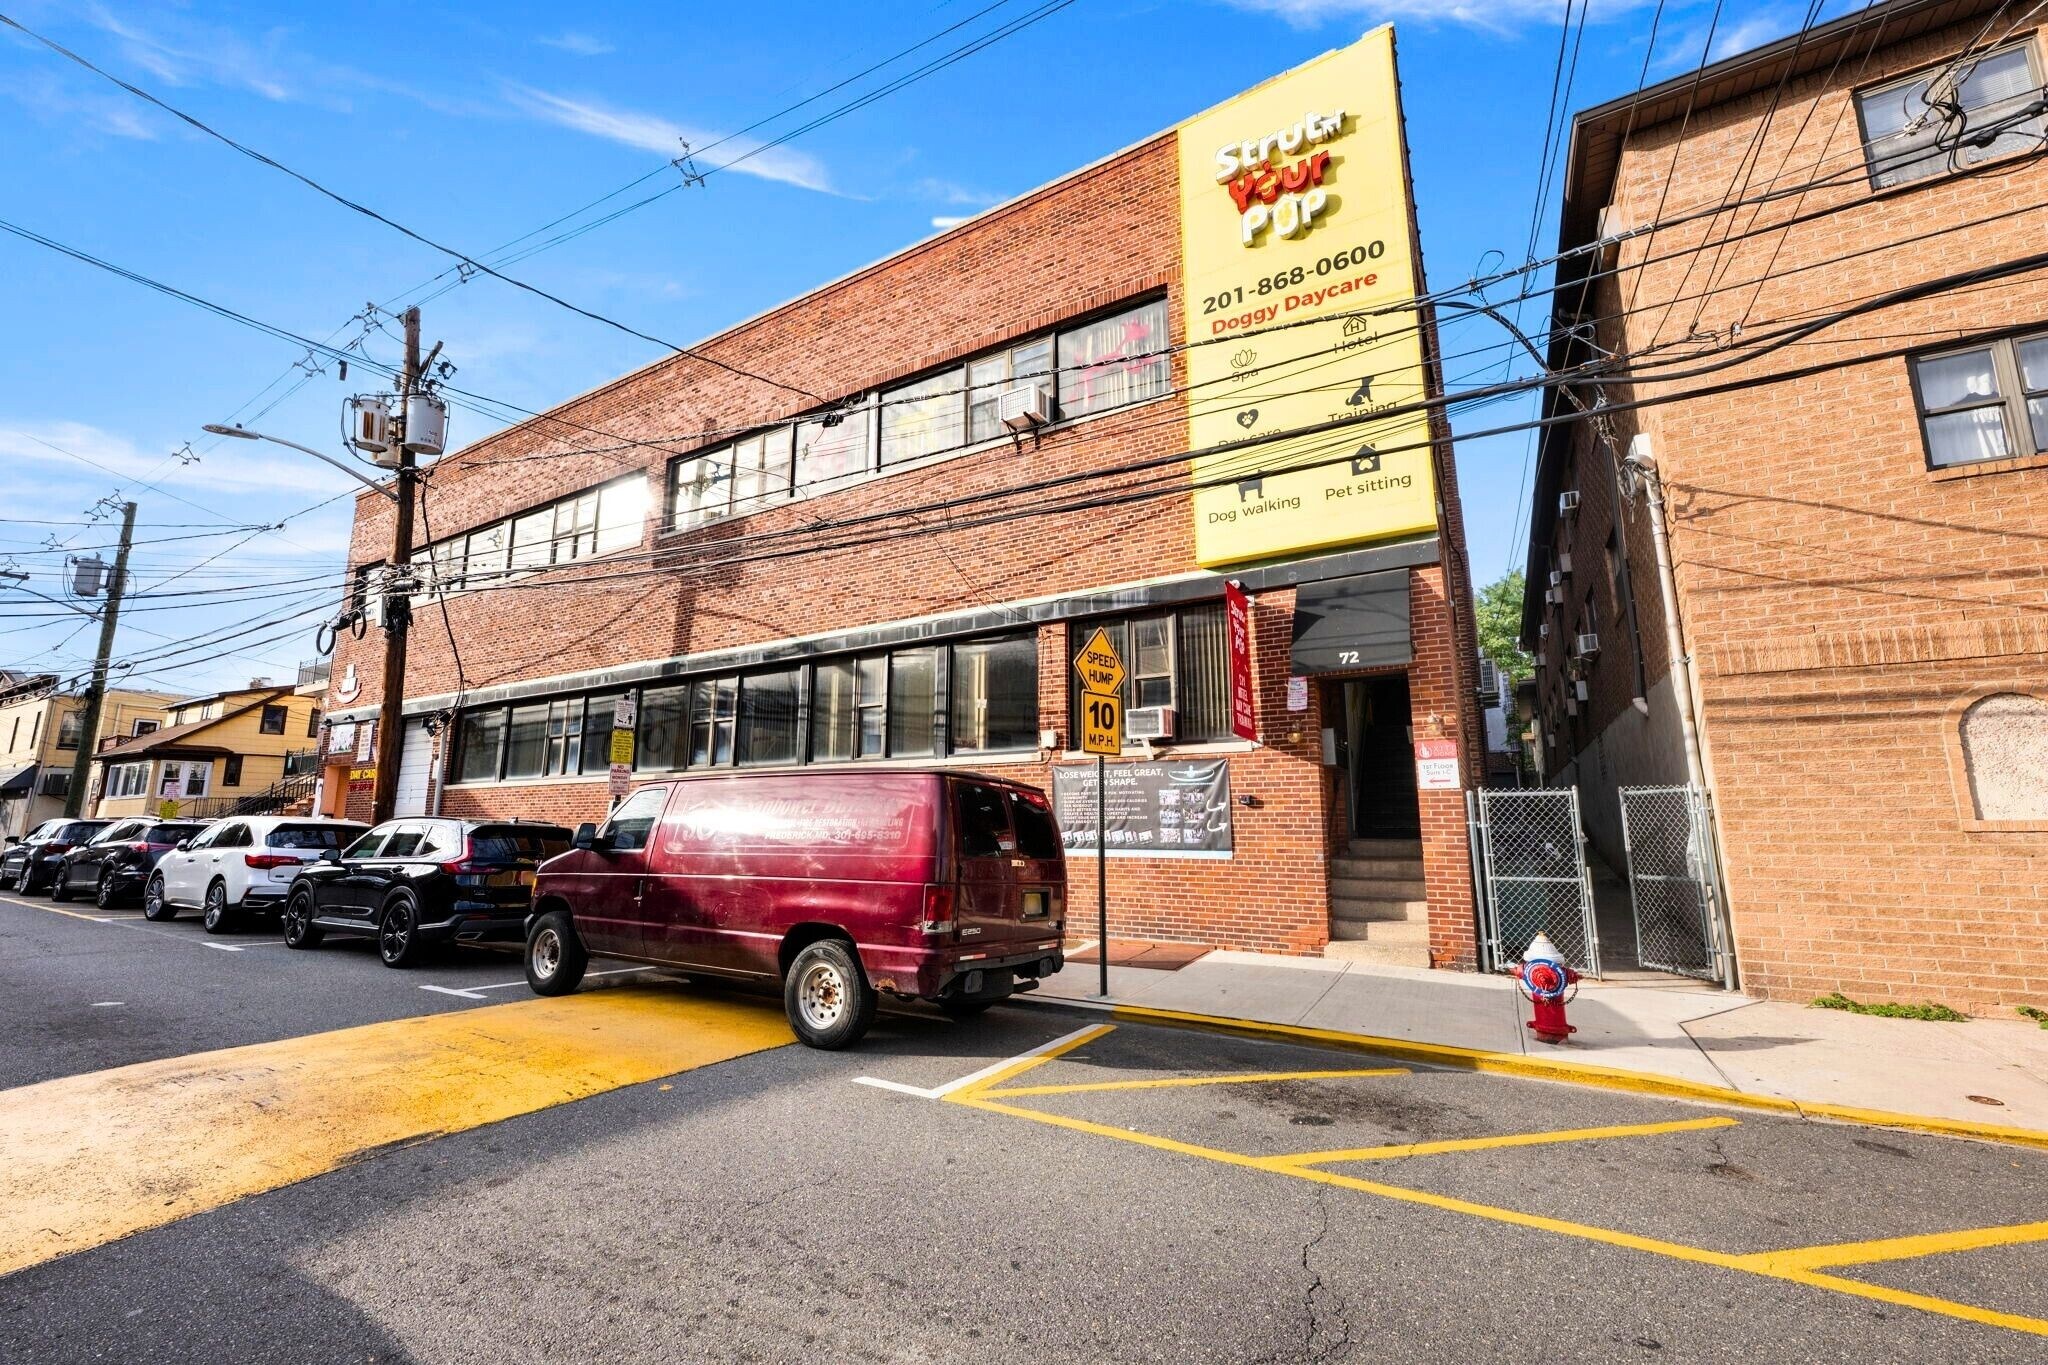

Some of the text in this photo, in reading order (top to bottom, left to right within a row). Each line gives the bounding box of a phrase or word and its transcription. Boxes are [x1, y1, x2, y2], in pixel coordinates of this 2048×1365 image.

[1203, 240, 1386, 315] 201-868-0600
[1212, 272, 1378, 335] Doggy Daycare
[1333, 331, 1379, 354] Hotel
[1231, 367, 1259, 385] Spa
[1325, 473, 1413, 501] Pet sitting
[1208, 494, 1302, 525] Dog walking
[1087, 650, 1116, 669] SPEED
[1339, 651, 1360, 664] 72
[1088, 668, 1114, 686] HUMP
[1089, 700, 1115, 730] 10
[1088, 733, 1116, 748] M.P.H.
[363, 767, 376, 779] CAR
[1059, 771, 1078, 779] LOSE
[1079, 770, 1112, 779] WEIGT,
[1134, 768, 1164, 777] GREAT,
[1083, 779, 1097, 787] GET
[1109, 778, 1138, 786] SHAPE.
[961, 927, 982, 936] E250
